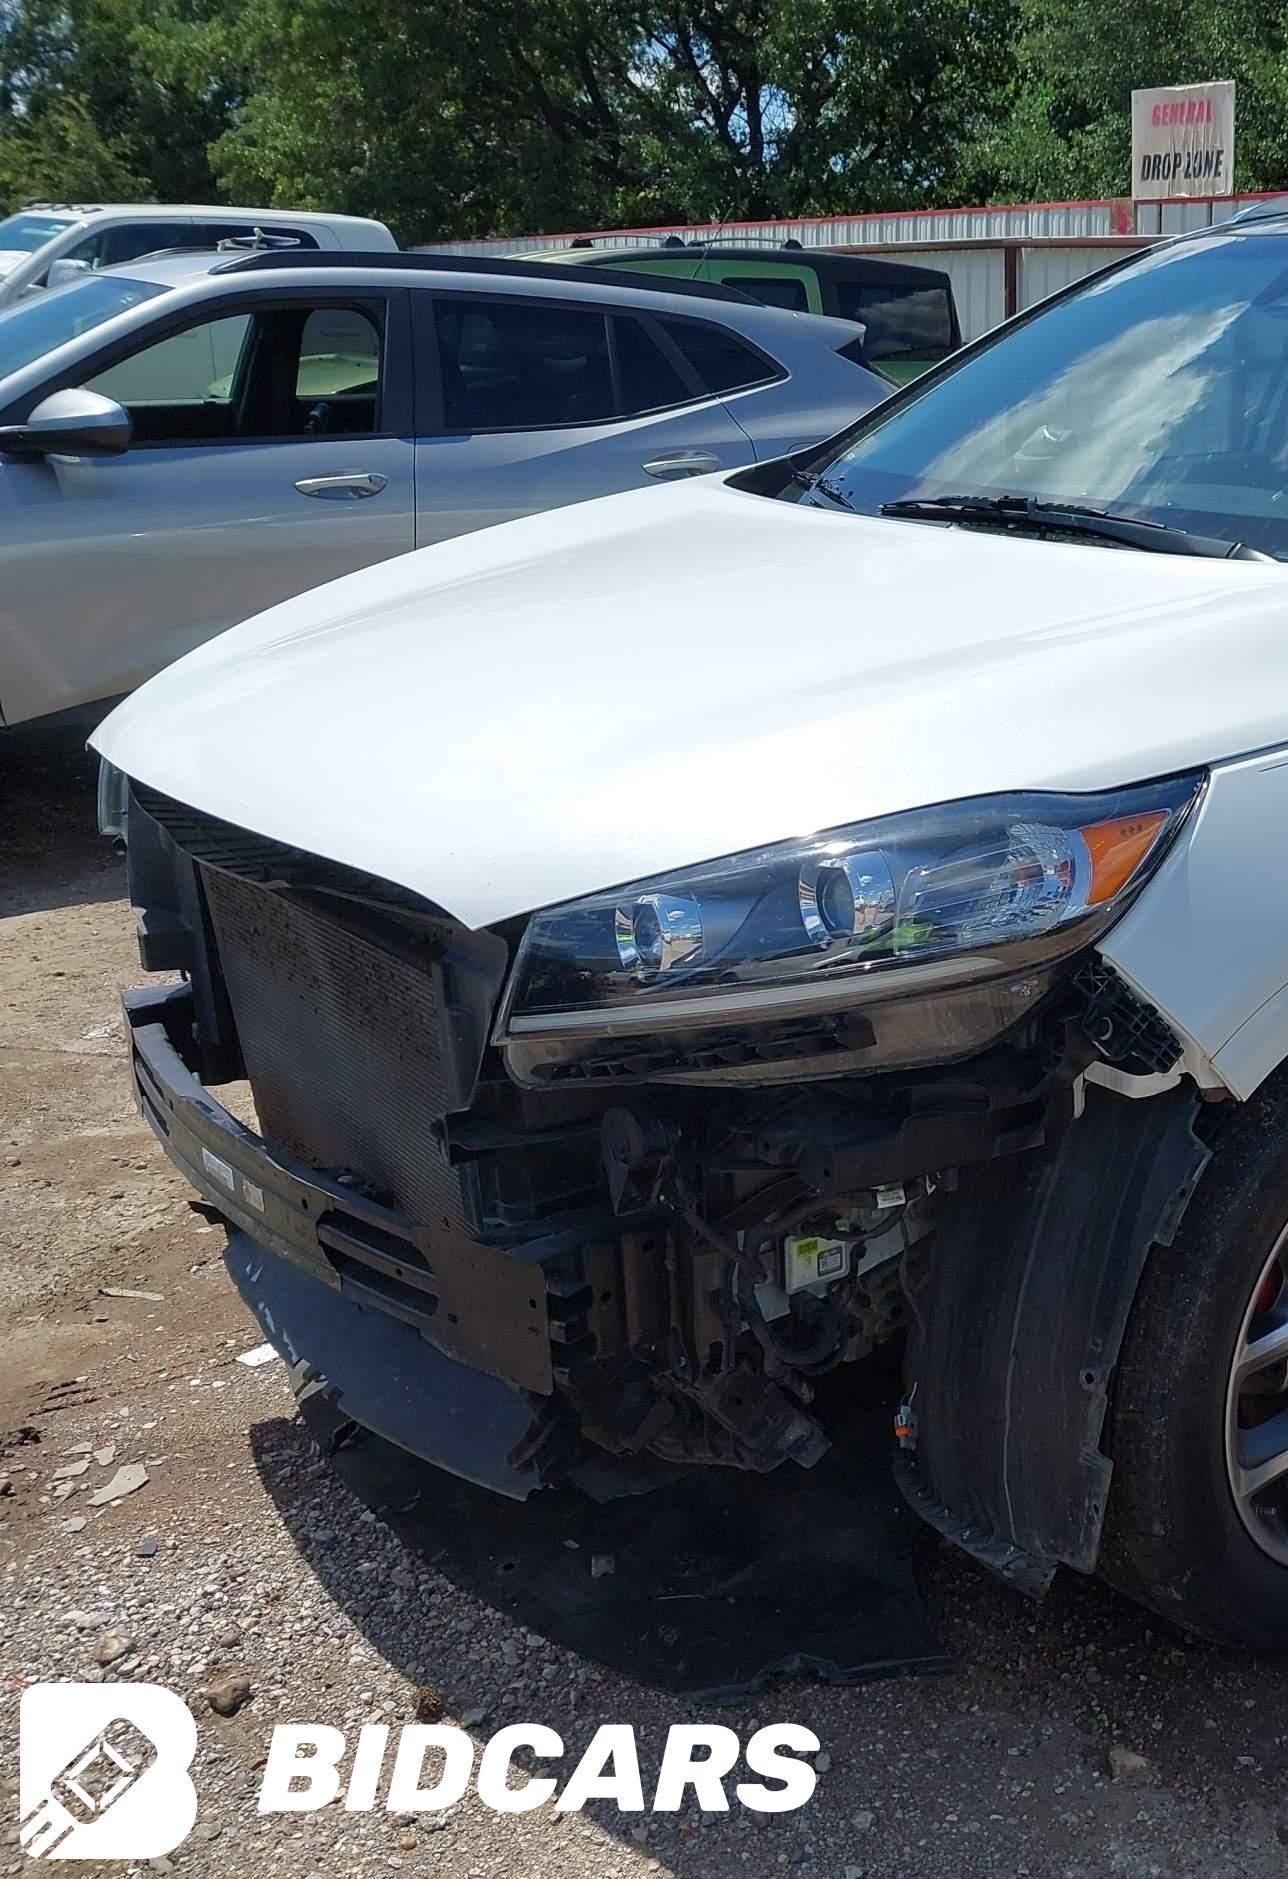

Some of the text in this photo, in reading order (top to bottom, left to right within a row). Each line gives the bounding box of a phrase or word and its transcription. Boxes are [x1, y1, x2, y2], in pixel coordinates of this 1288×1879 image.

[1152, 100, 1213, 127] GENERAL
[1140, 149, 1224, 181] DROP ZONE
